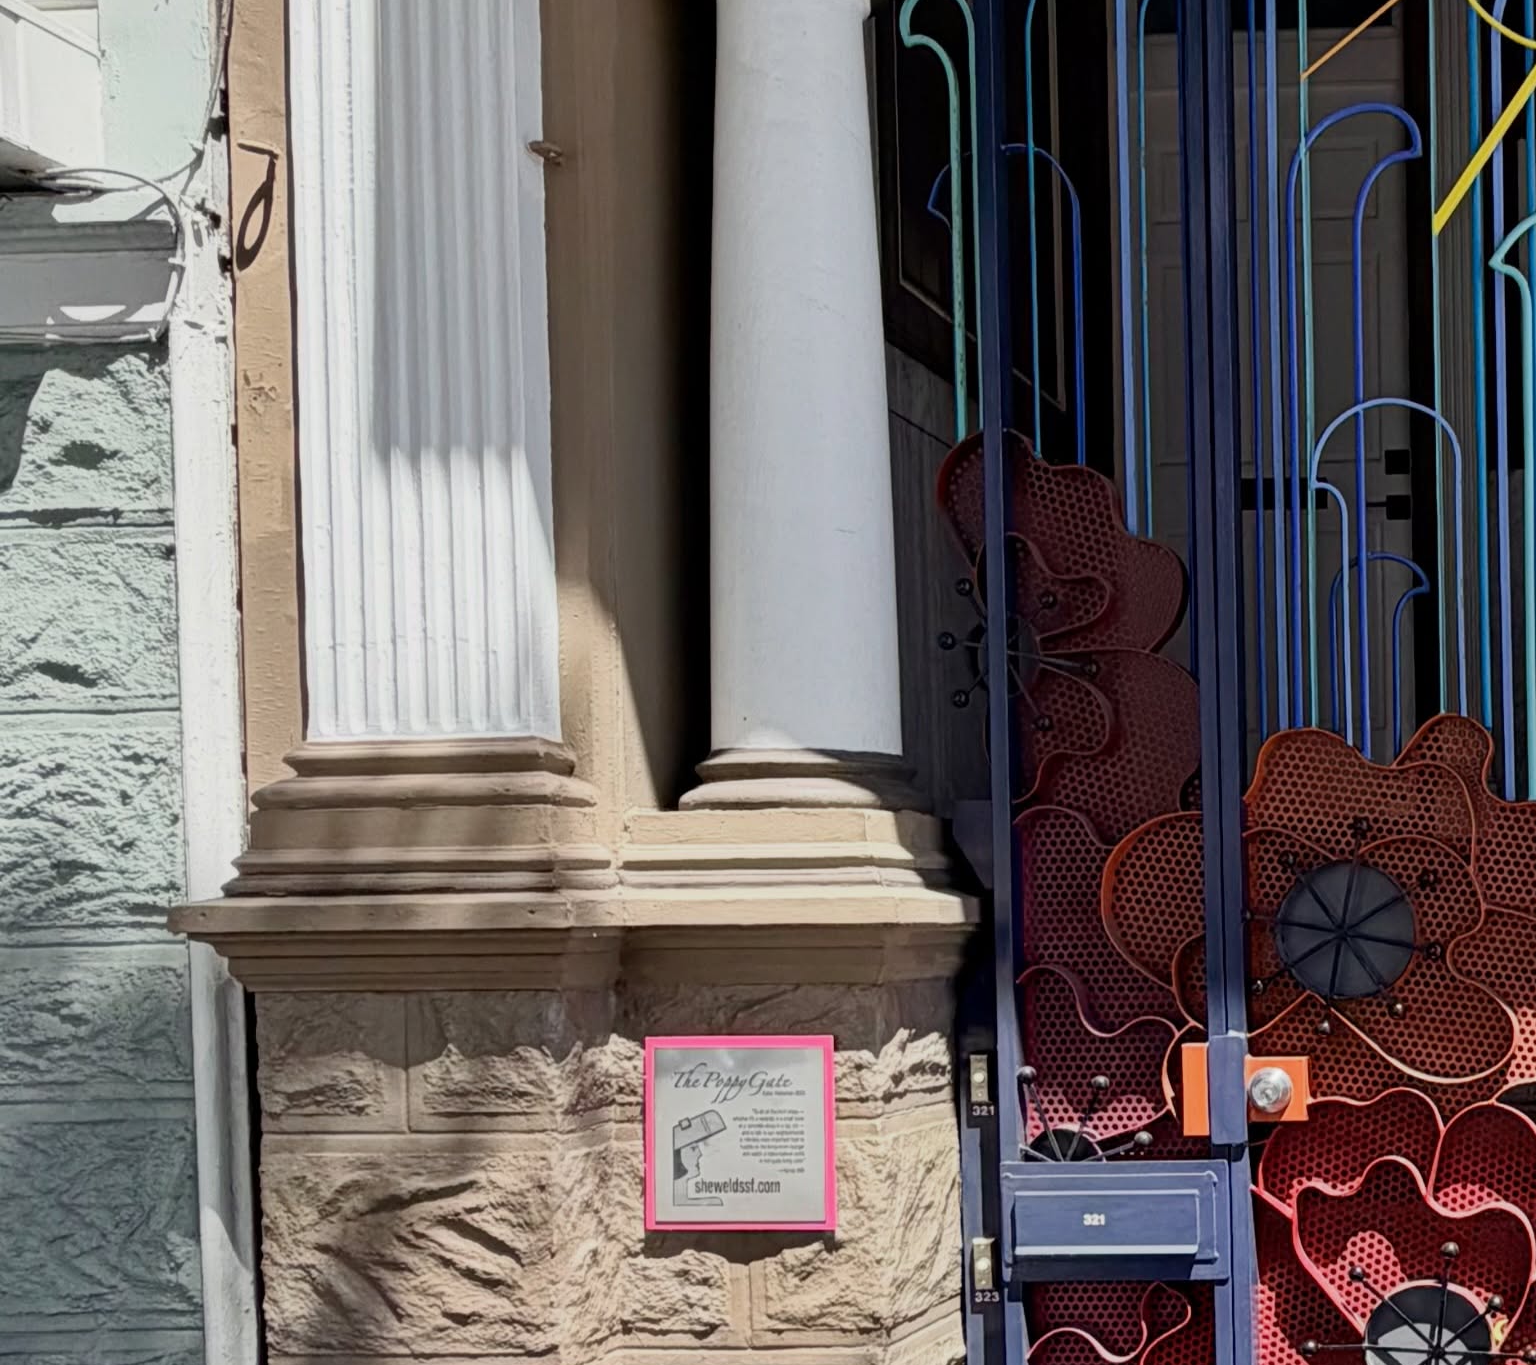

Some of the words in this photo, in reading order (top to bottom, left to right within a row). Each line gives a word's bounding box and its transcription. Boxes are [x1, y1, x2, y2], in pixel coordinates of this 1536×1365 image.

[674, 1062, 707, 1088] The
[703, 1071, 747, 1104] Poppy
[748, 1070, 792, 1097] Gate
[972, 1105, 995, 1116] 321
[694, 1177, 781, 1194] sheweldssf.com
[1083, 1213, 1105, 1226] 321
[975, 1291, 1000, 1302] 323
